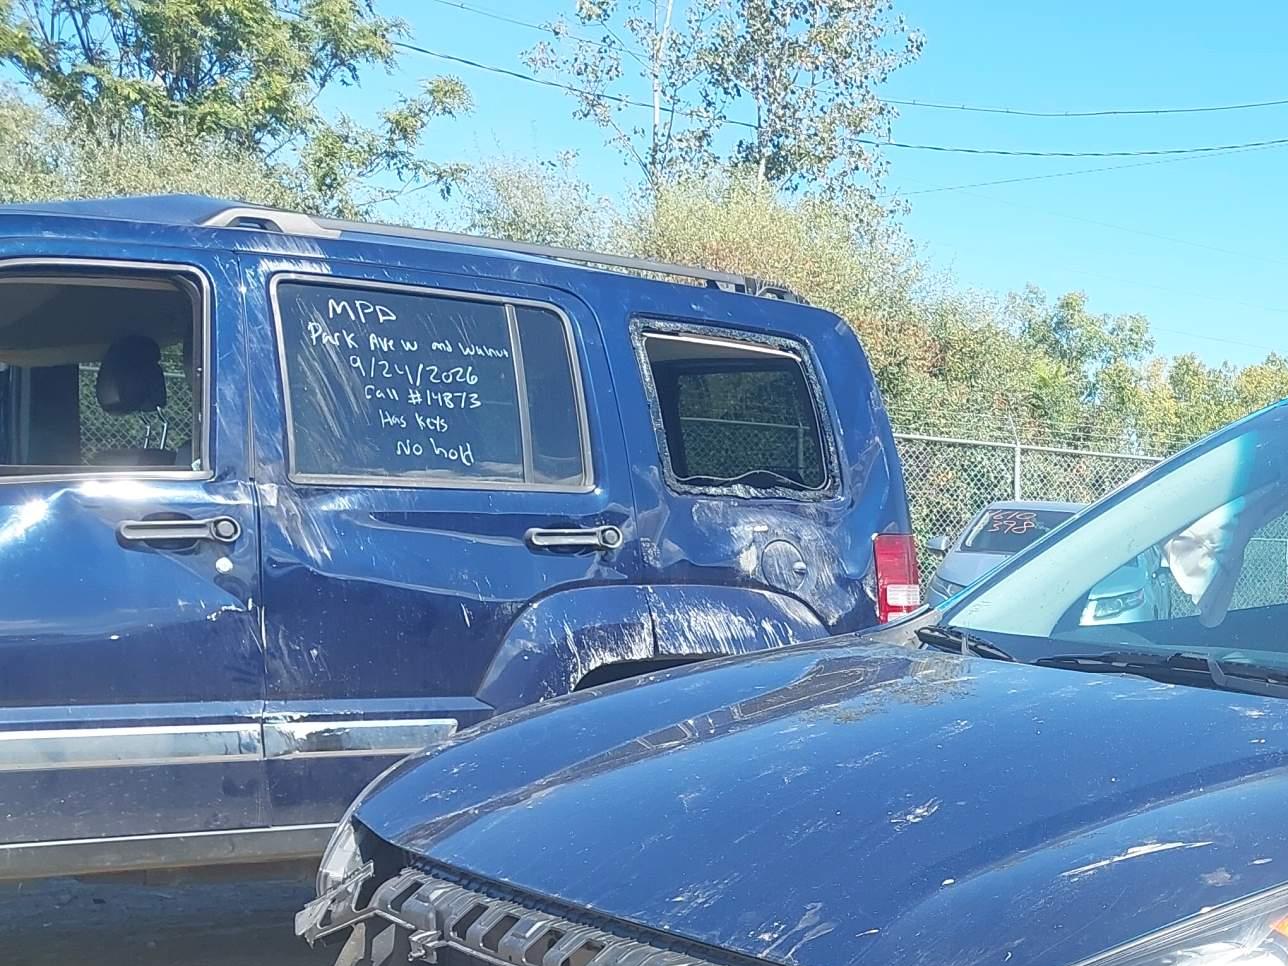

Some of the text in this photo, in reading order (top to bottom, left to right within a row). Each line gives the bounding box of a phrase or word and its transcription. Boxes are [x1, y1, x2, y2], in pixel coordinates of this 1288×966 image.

[328, 298, 397, 324] MPD
[307, 321, 359, 349] Park
[369, 333, 395, 352] Ave
[431, 339, 453, 353] and
[458, 342, 510, 358] Walnut
[349, 354, 479, 387] 9/24/2026
[407, 388, 481, 409] #14873
[379, 409, 408, 429] Has
[396, 437, 475, 466] No hold
